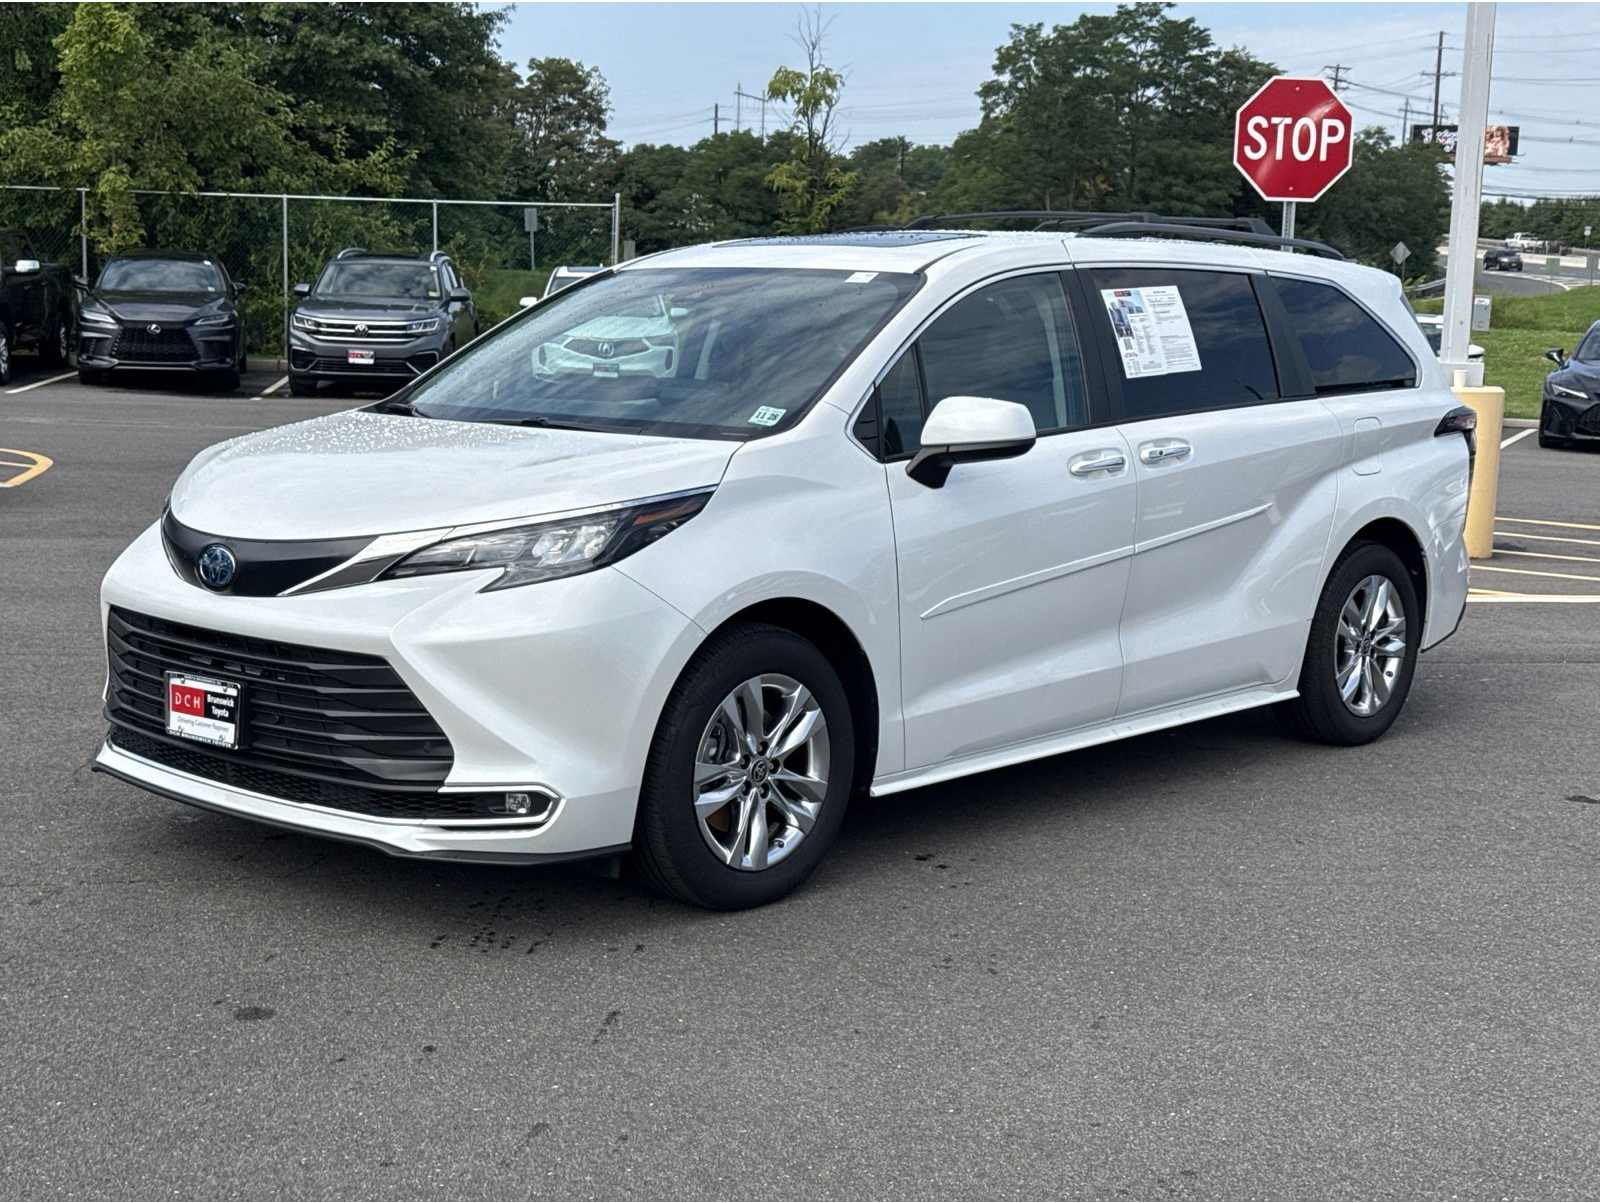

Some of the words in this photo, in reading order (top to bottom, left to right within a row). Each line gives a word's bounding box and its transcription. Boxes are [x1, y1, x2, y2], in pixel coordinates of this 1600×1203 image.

[1243, 115, 1345, 162] STOP
[175, 692, 201, 709] DCH
[211, 705, 229, 718] Toyota
